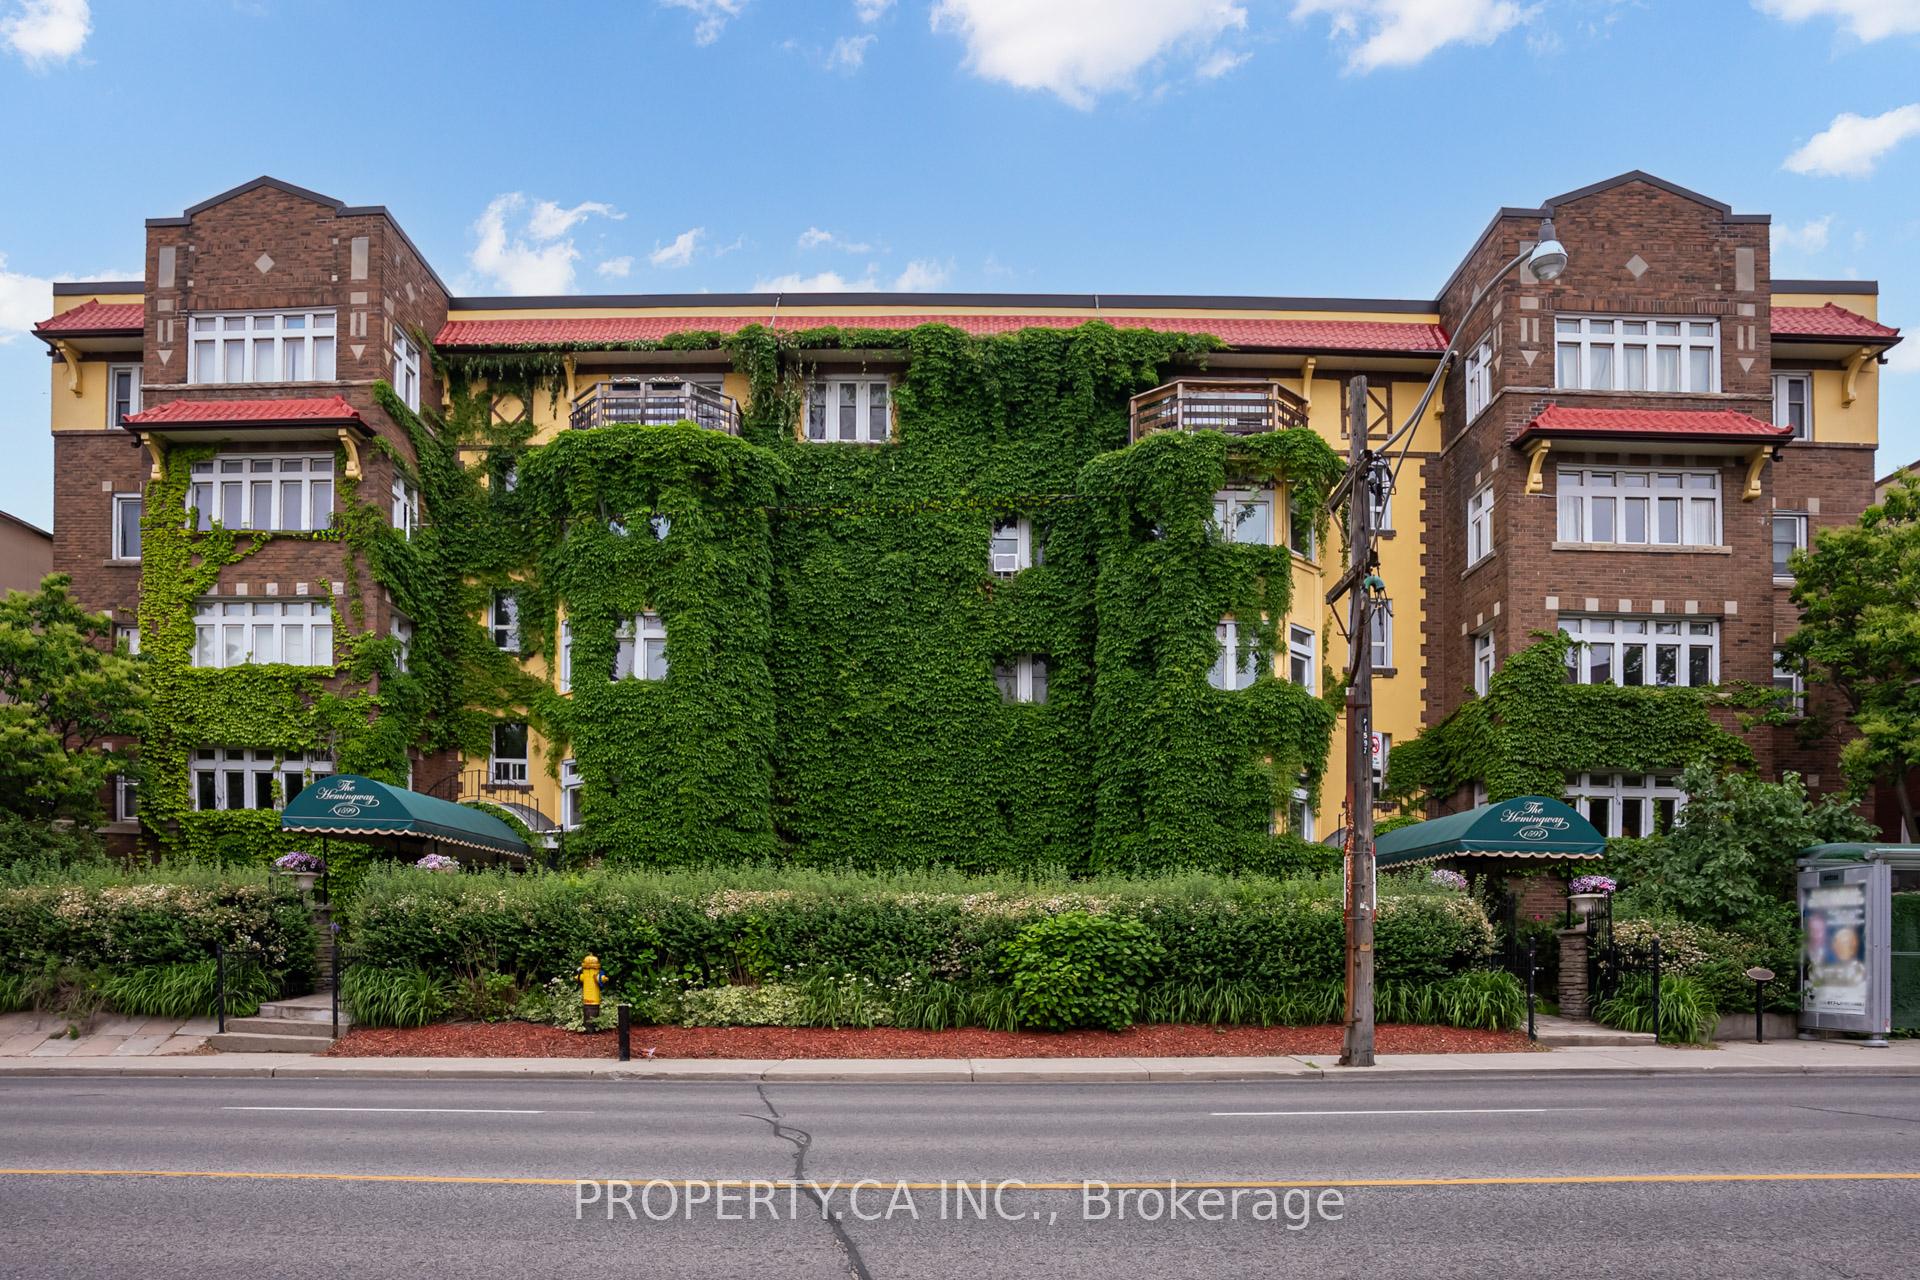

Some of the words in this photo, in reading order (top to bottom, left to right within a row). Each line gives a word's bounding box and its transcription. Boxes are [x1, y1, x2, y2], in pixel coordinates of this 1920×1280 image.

[337, 779, 356, 791] The
[315, 786, 380, 807] Hemingway
[1524, 801, 1544, 814] The
[1500, 809, 1570, 830] Hemingway
[1523, 830, 1544, 838] 1597
